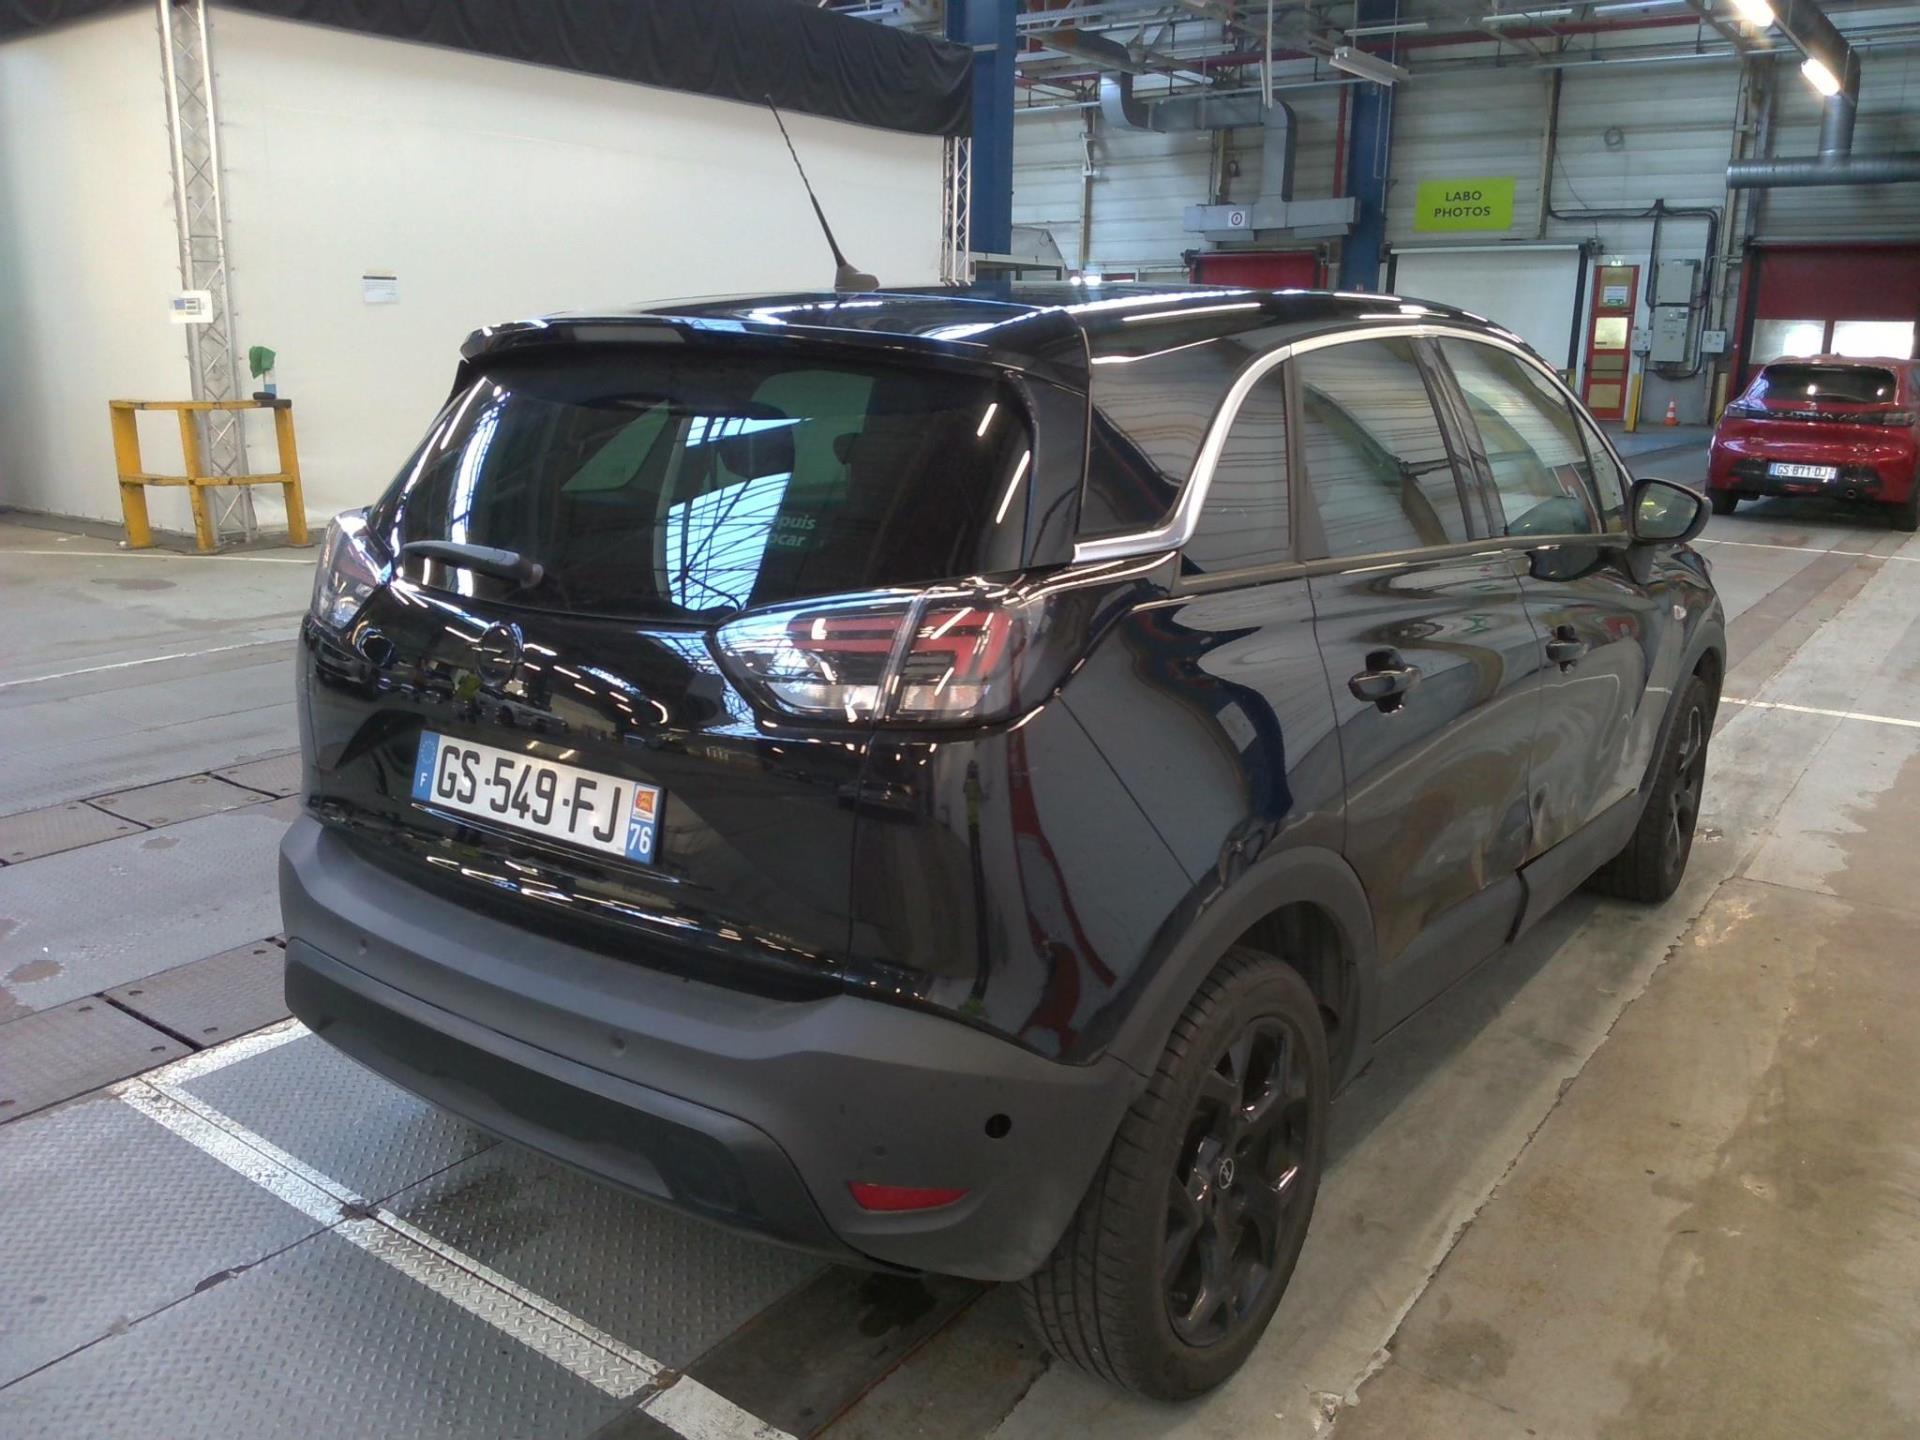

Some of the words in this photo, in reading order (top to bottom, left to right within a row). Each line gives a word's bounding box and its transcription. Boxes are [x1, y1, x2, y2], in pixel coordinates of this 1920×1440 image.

[1445, 190, 1482, 202] LABO
[1434, 206, 1491, 218] PHOTOS
[419, 772, 429, 787] F
[629, 823, 652, 854] 76
